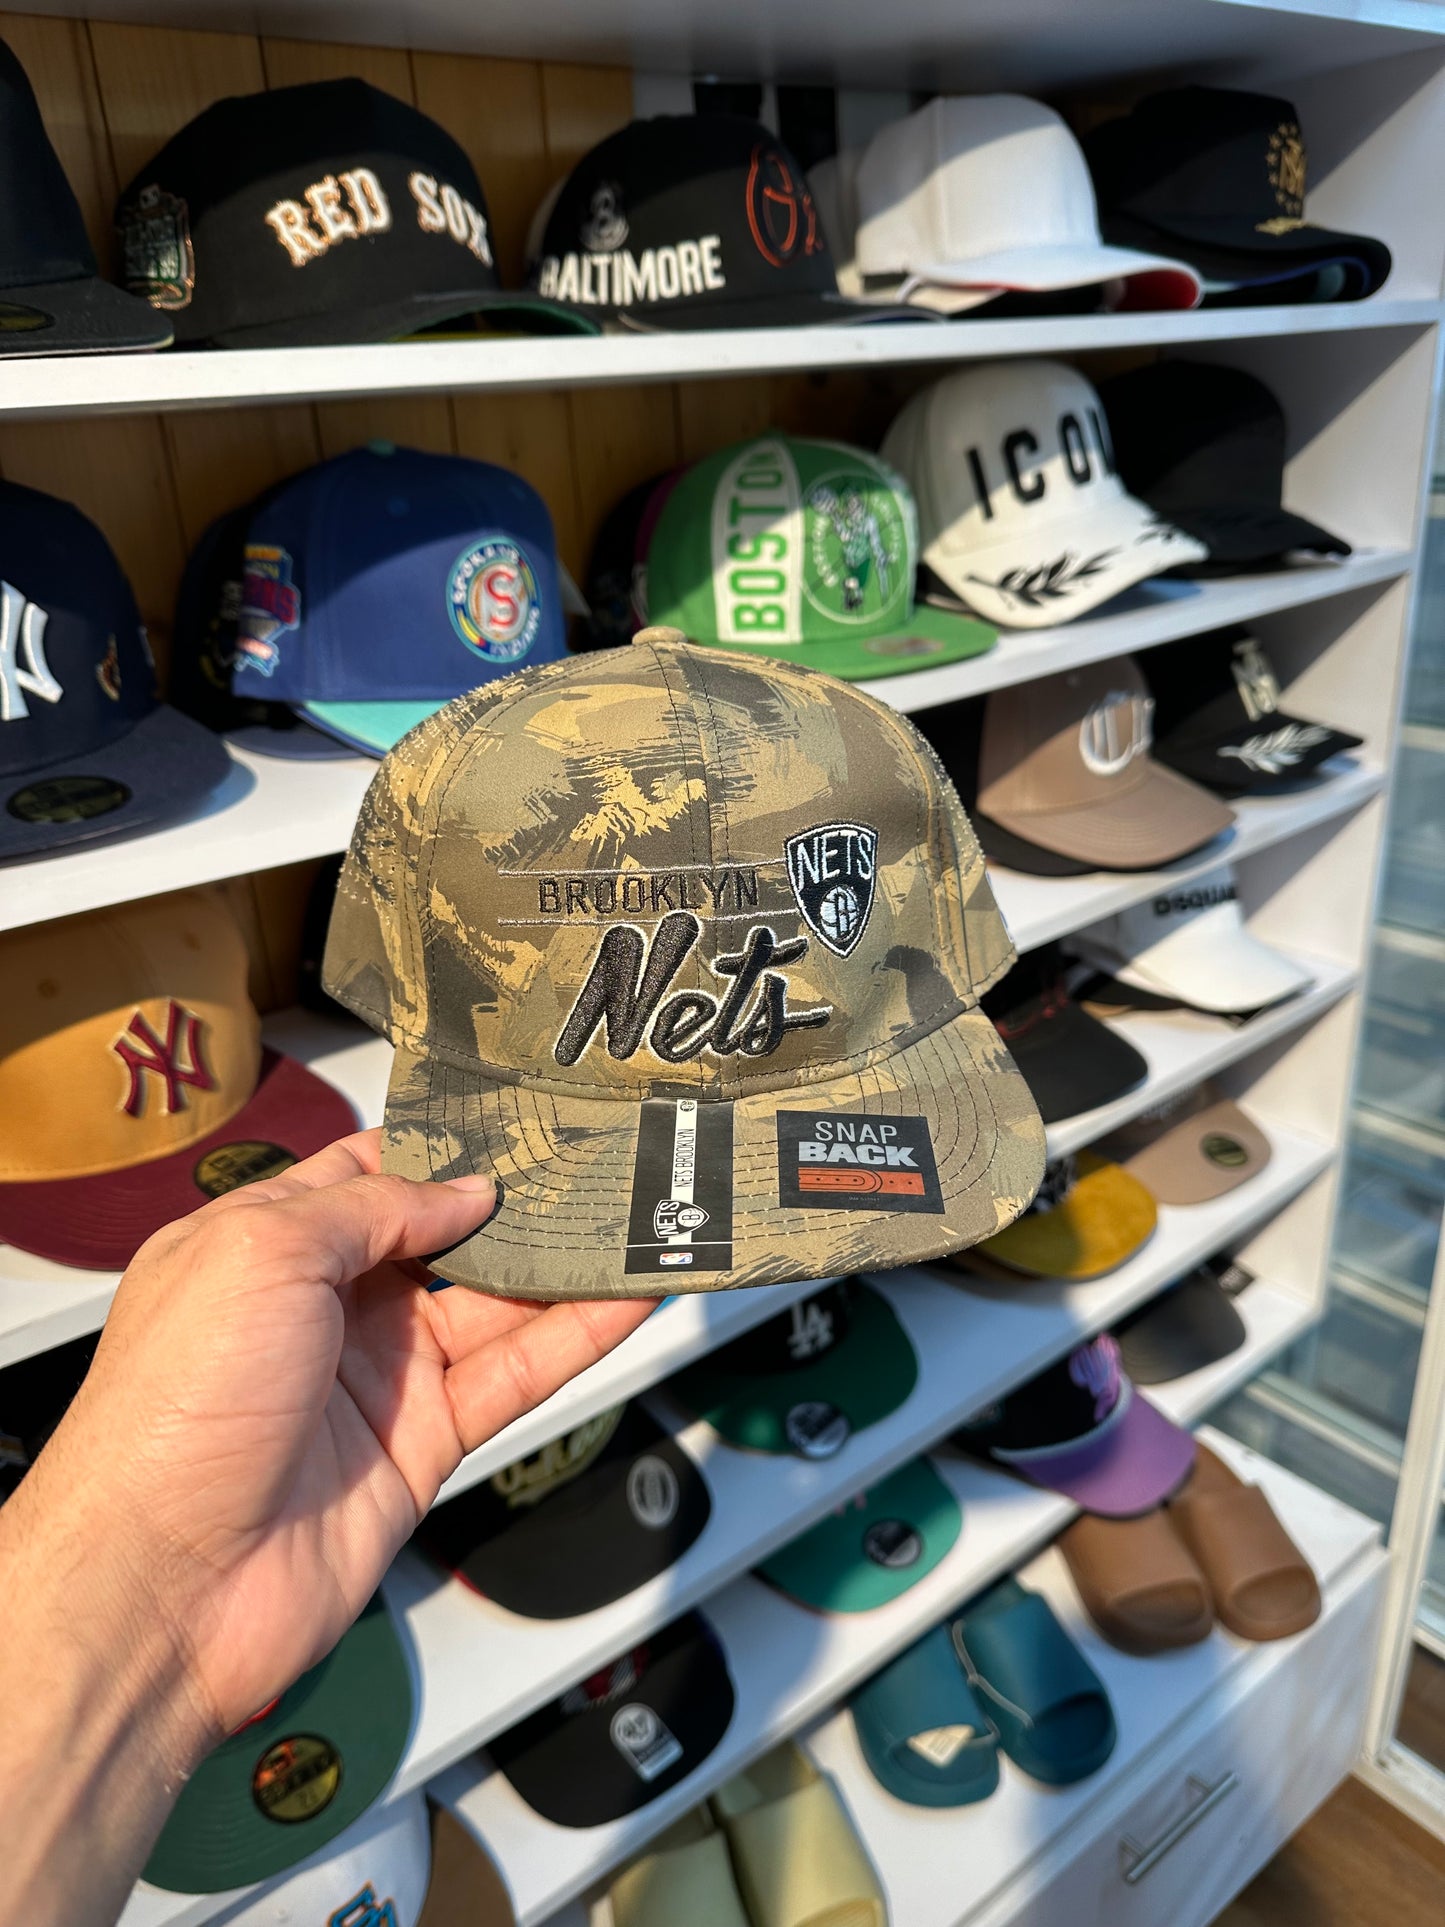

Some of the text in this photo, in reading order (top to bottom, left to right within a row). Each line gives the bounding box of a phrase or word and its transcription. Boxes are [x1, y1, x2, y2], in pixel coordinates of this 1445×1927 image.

[265, 168, 391, 267] RED
[408, 172, 493, 268] SOX
[539, 234, 727, 306] BALTIMORE
[796, 830, 875, 892] NETS
[537, 868, 759, 915] BROOKLYN
[553, 909, 834, 1067] Nets
[109, 997, 219, 1119] NY
[675, 1128, 695, 1168] BROOKLYN
[798, 1141, 919, 1167] BACK
[815, 1120, 898, 1145] SNAP
[674, 1170, 693, 1188] NETS
[656, 1201, 680, 1236] NETS
